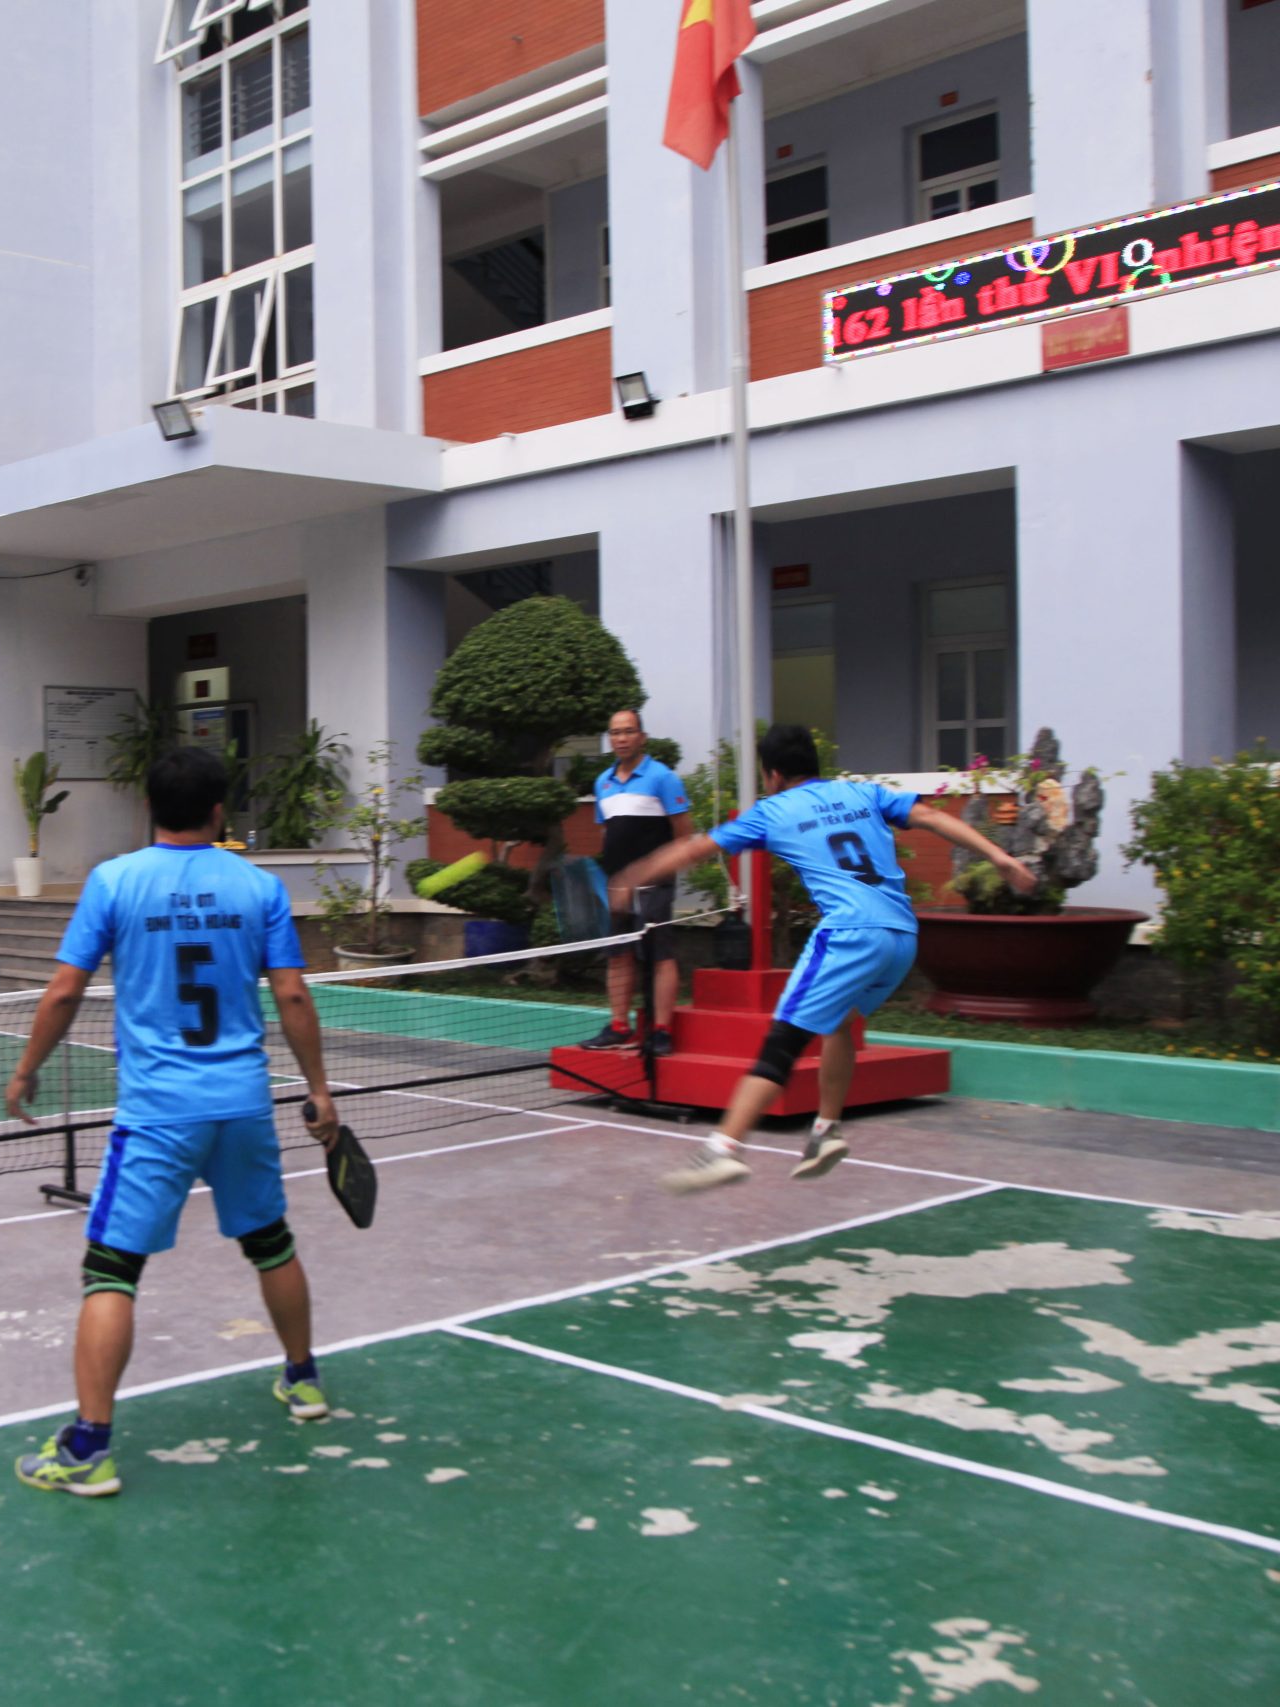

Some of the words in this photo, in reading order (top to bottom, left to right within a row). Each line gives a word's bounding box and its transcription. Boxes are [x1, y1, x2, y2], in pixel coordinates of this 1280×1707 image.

[901, 285, 968, 332] lần
[975, 270, 1052, 316] thứ
[826, 830, 886, 888] 9
[174, 942, 218, 1048] 5
